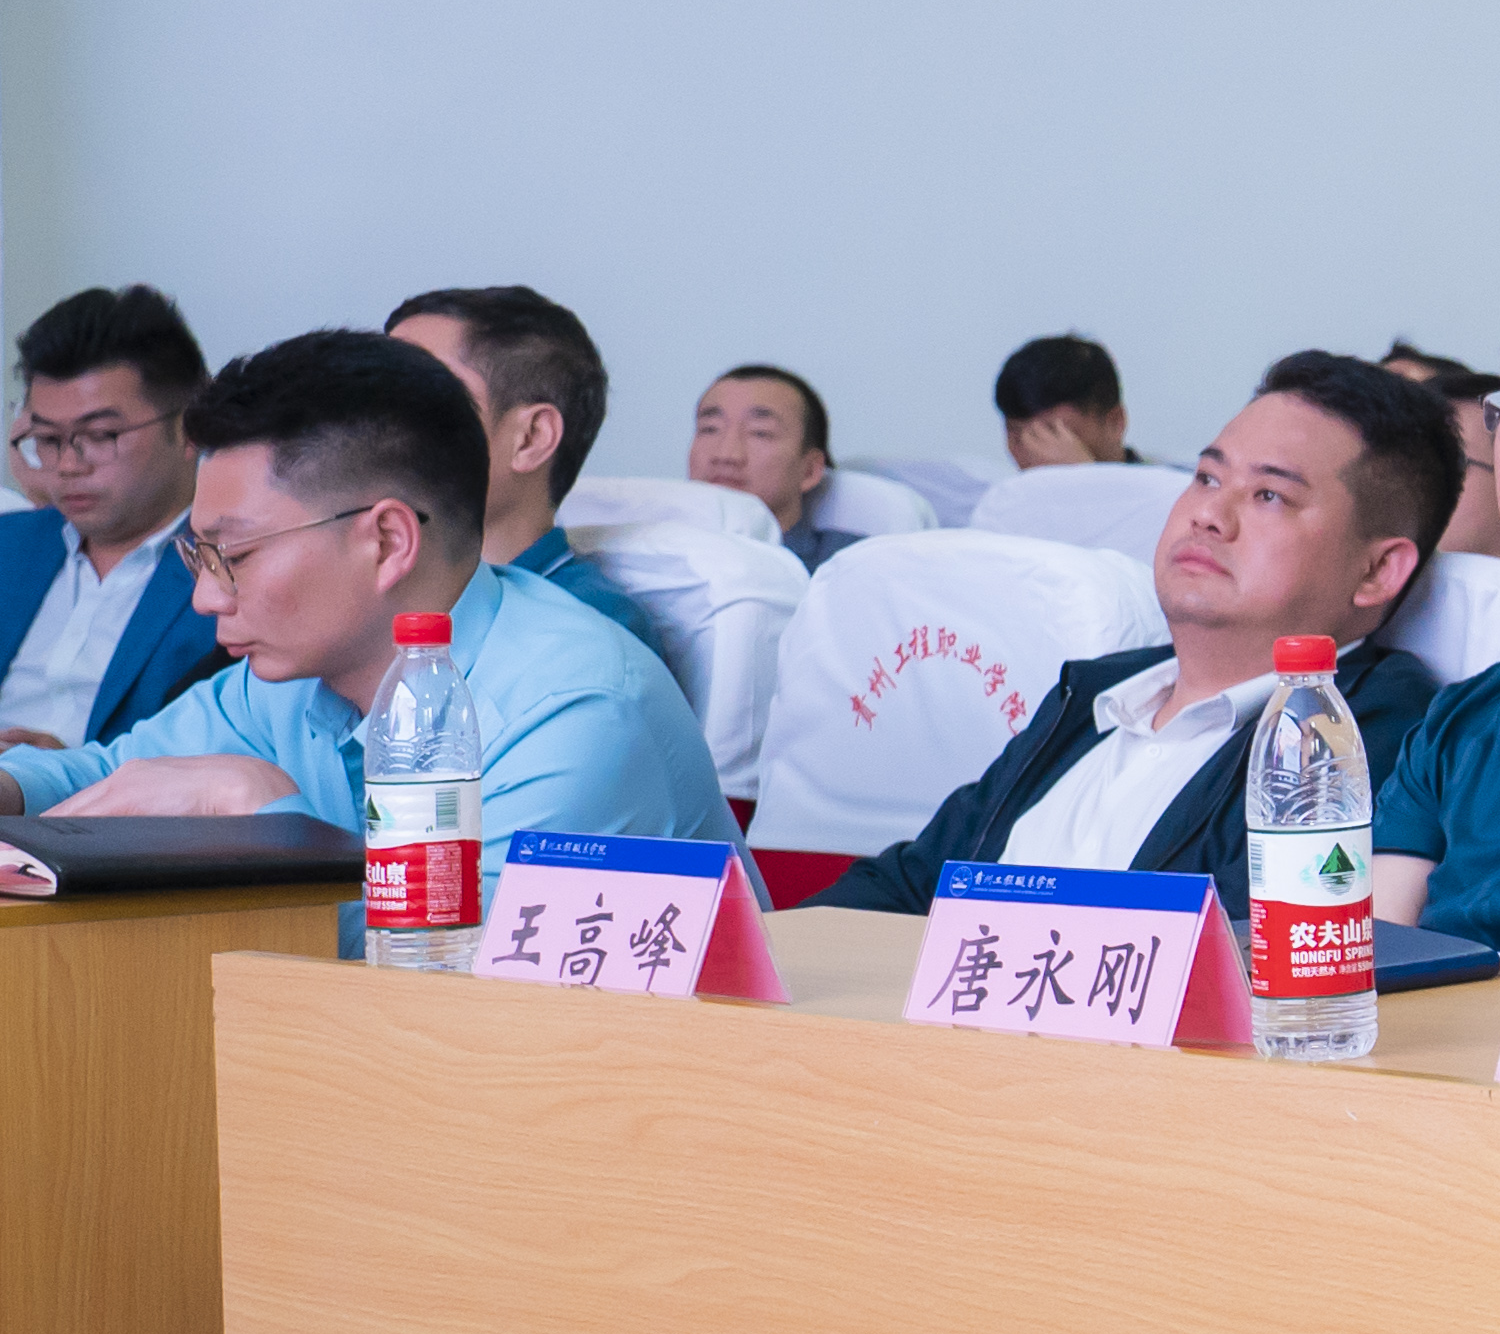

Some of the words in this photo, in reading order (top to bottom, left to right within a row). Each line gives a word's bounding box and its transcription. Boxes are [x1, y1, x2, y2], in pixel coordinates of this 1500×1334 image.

[851, 625, 1026, 736] 贵州工程职业学院
[372, 886, 407, 899] SPRING
[491, 893, 686, 992] 王高峰
[1289, 915, 1373, 949] 农夫山泉
[1290, 949, 1342, 965] NONGFU
[927, 924, 1162, 1025] 唐永刚
